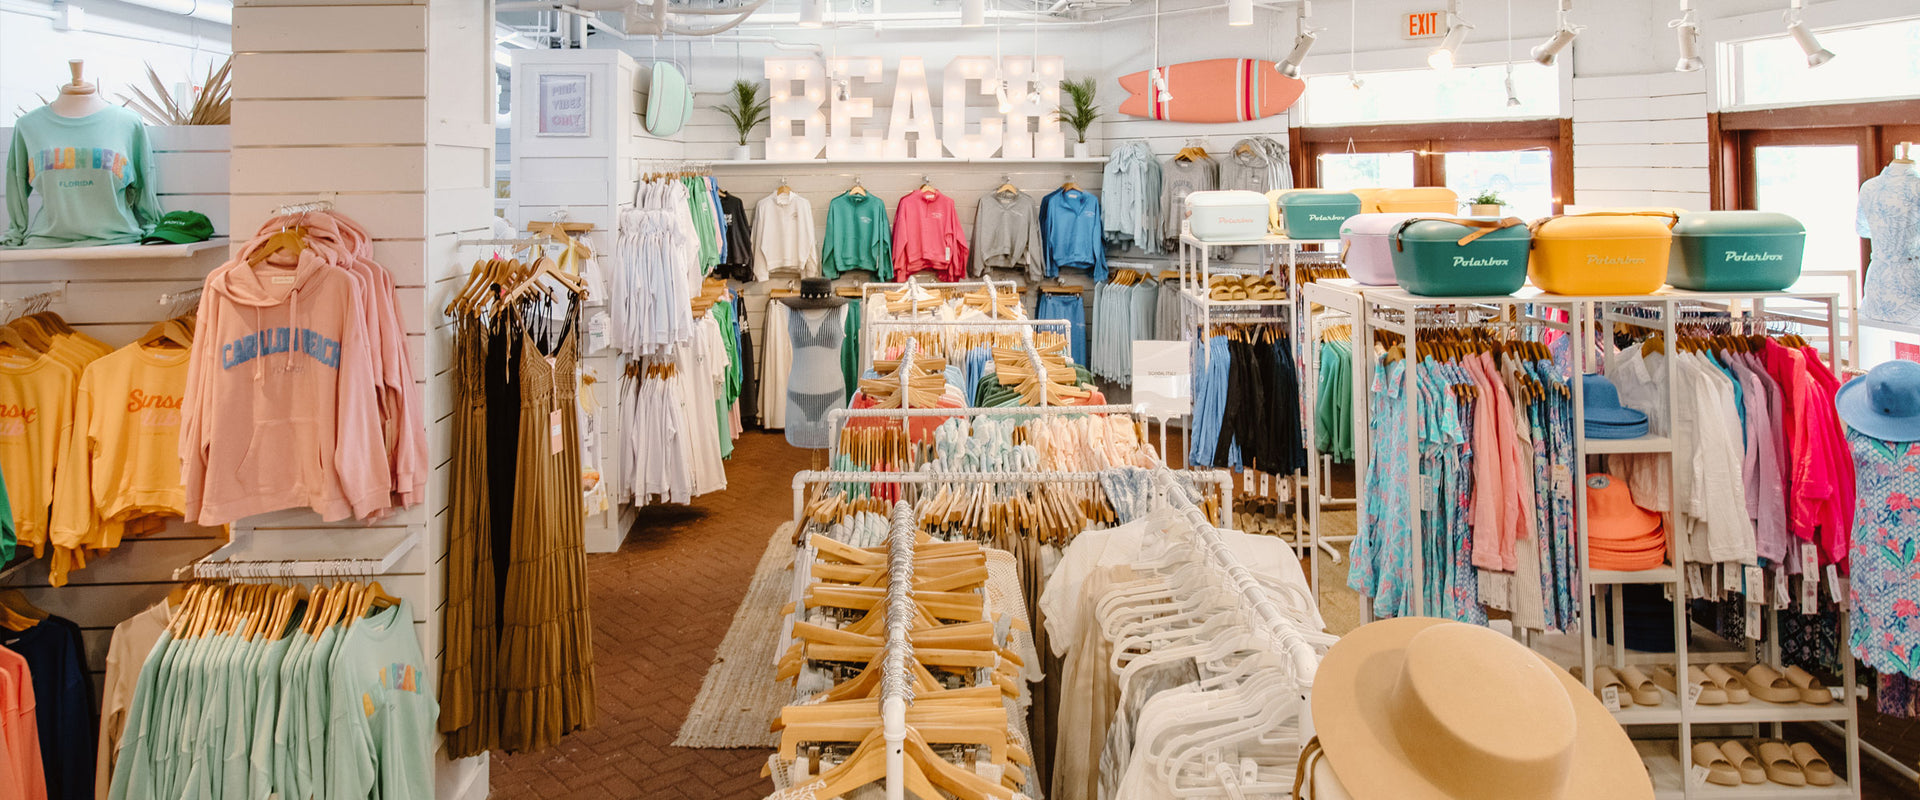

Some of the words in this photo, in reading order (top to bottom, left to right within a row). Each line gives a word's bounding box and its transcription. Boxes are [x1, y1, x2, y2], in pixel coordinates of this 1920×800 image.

[1409, 12, 1438, 36] EXIT
[764, 56, 1064, 159] BEACH
[1309, 214, 1346, 222] Polarbox
[1452, 256, 1510, 267] Polarbox
[1586, 254, 1646, 266] Polarbox
[1725, 250, 1784, 262] Polarbox
